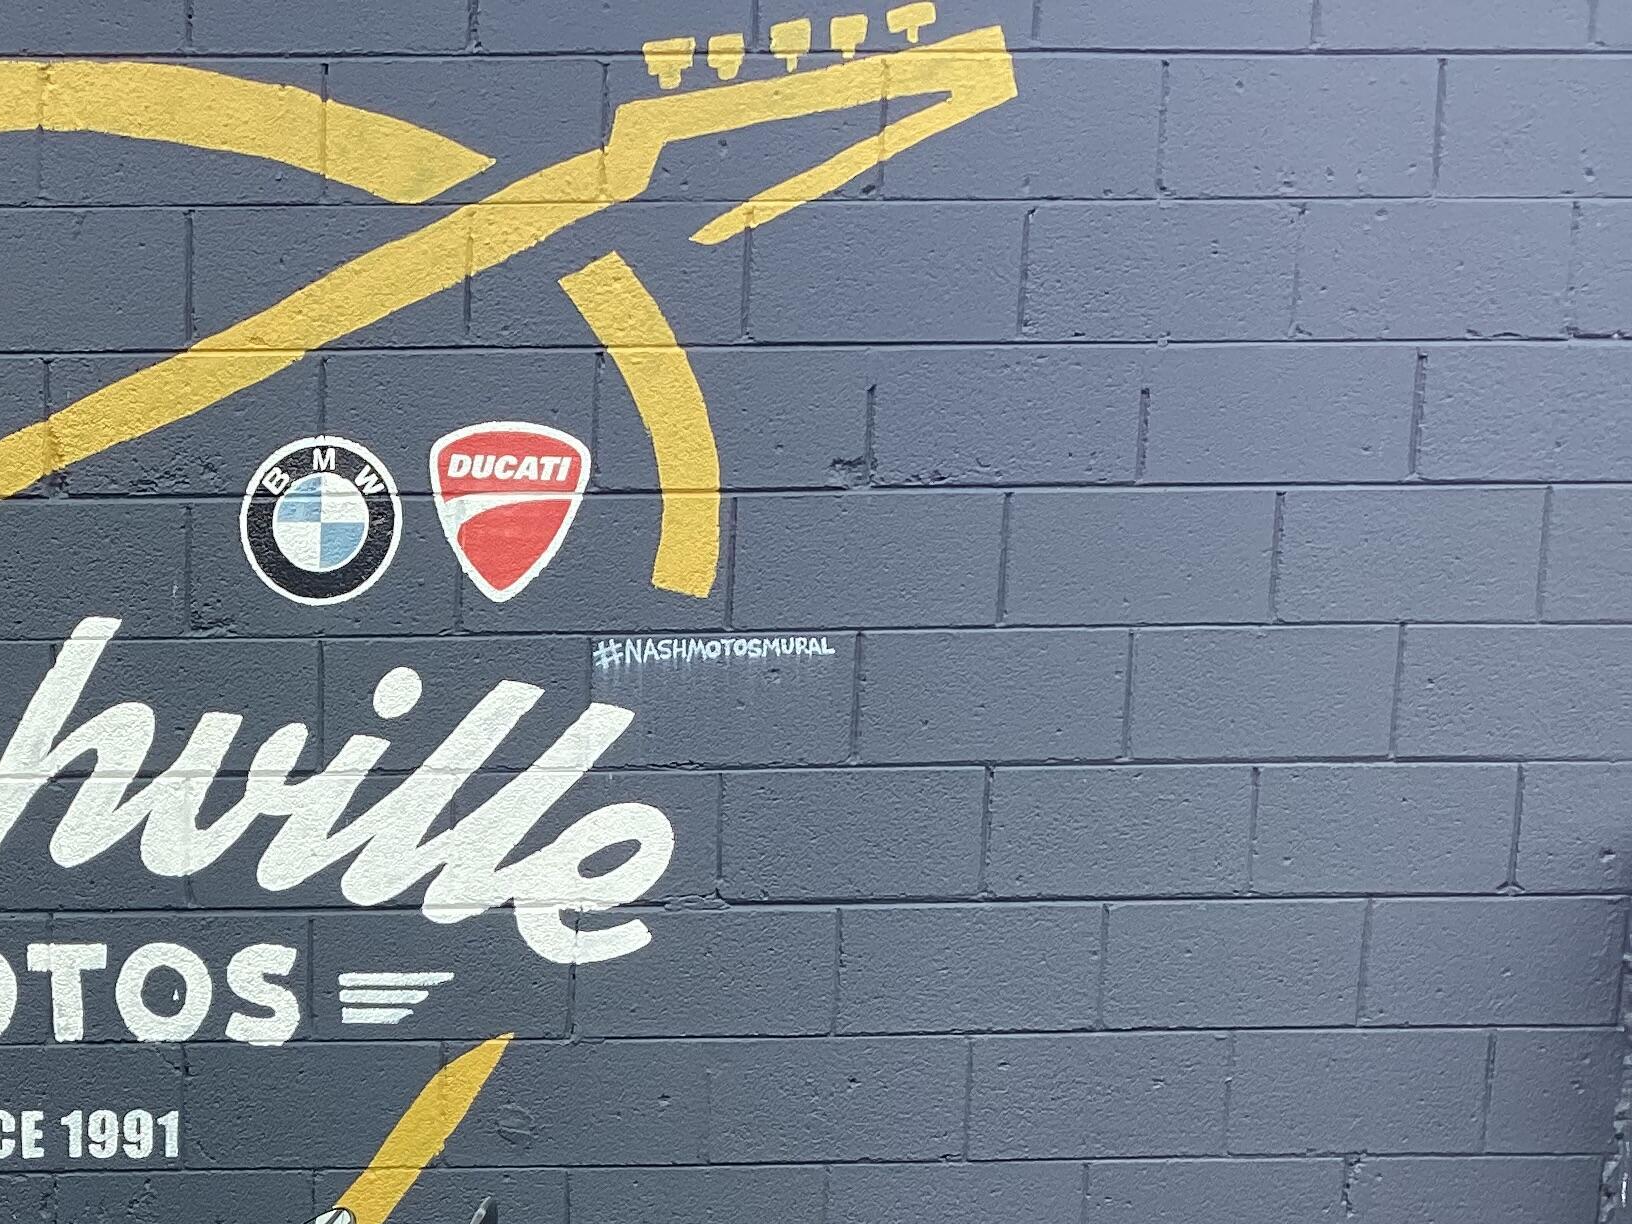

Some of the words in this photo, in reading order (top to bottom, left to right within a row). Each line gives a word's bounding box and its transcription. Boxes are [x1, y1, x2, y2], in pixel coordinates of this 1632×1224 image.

[262, 447, 384, 495] BMW
[448, 453, 573, 482] DUCATI
[592, 636, 836, 669] #NASHMOTOSMURAL
[60, 1109, 179, 1160] 1991
